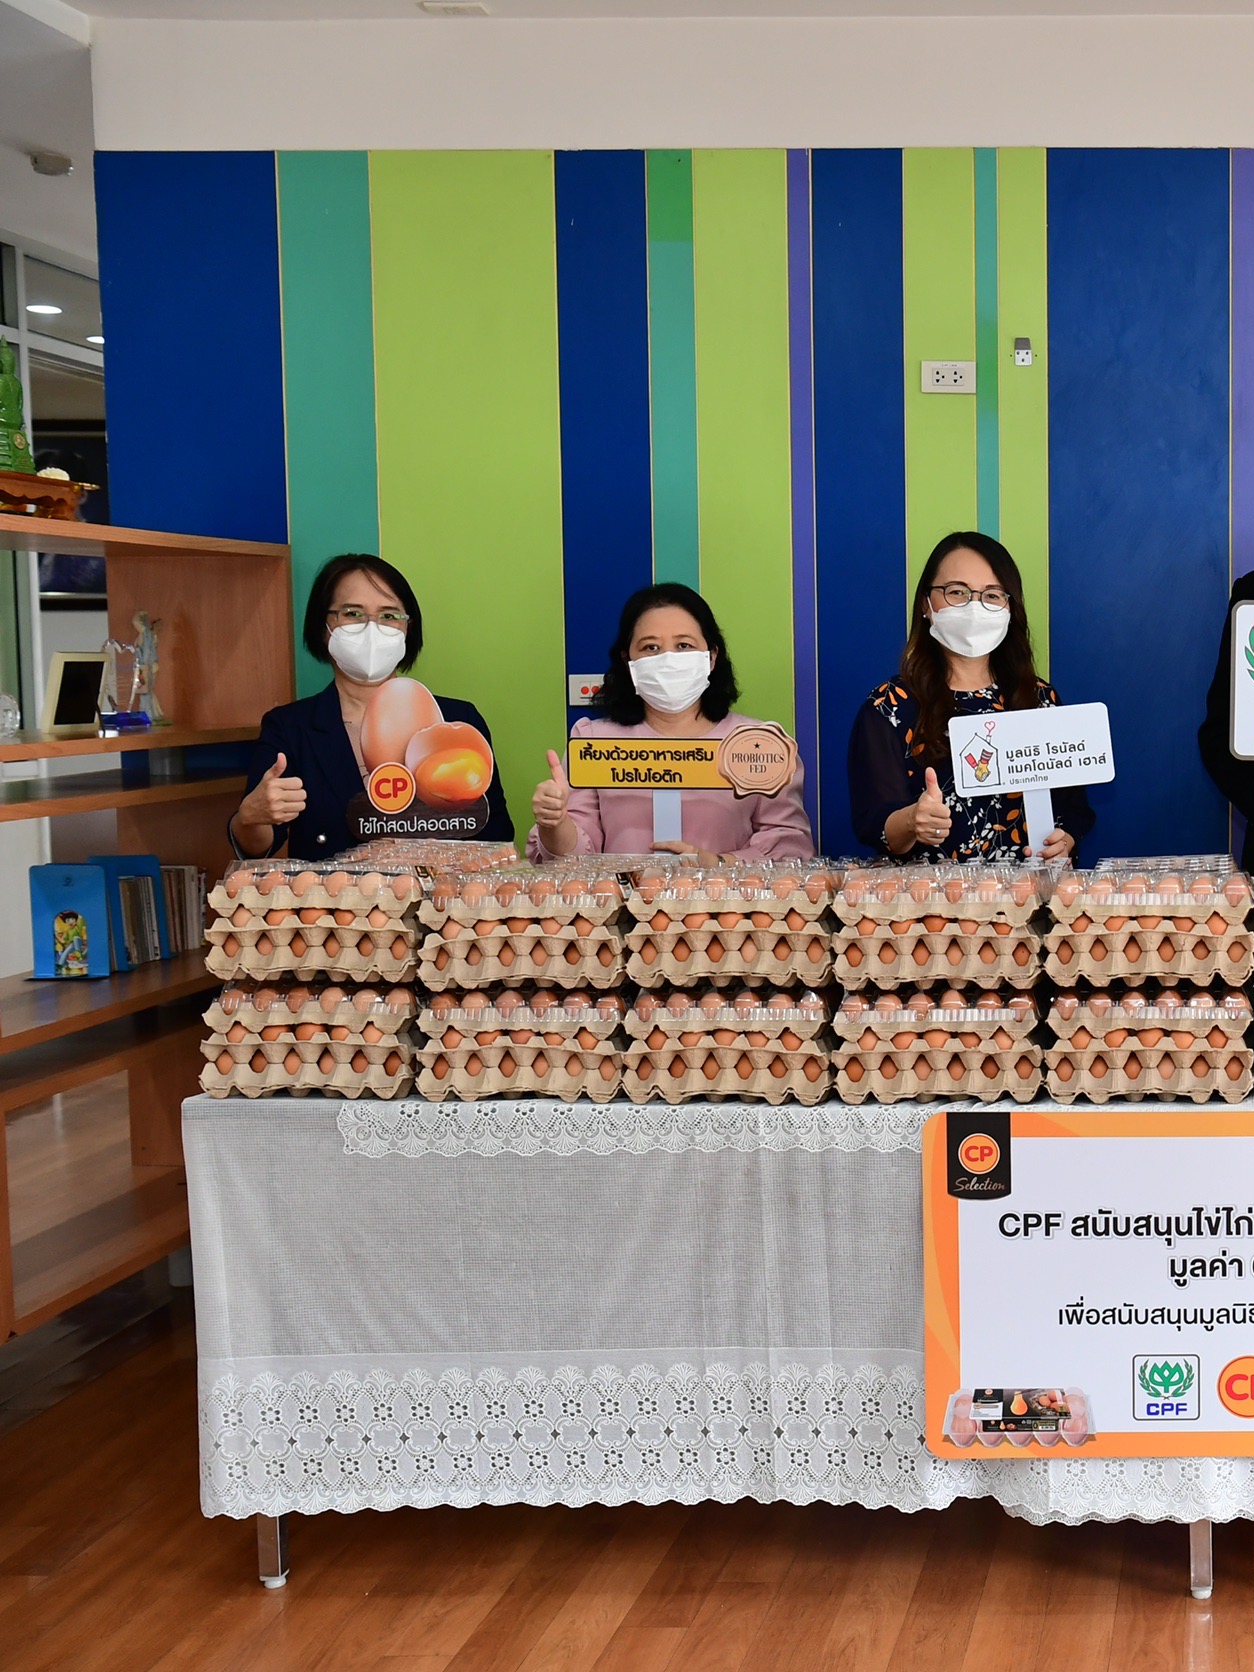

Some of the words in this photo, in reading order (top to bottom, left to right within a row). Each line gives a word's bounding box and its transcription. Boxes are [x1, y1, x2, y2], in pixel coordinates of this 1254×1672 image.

[580, 742, 714, 761] เลี้ยงด้วยอาหารเสริม
[731, 752, 785, 763] PROBIOTICS
[1005, 745, 1041, 762] มูลนิธิ
[1046, 739, 1086, 756] โรนัลด์
[749, 764, 767, 774] FED
[1007, 757, 1073, 774] แมคโดนัลด์
[1078, 753, 1107, 767] เฮาส์
[610, 767, 682, 783] โปรไบโอติก
[1009, 774, 1049, 786] ประเทศไทย
[374, 778, 408, 799] CP
[358, 816, 477, 834] ไข่ไก่สดปลอดสาร
[964, 1145, 994, 1162] CP
[953, 1176, 1005, 1192] Selection
[999, 1213, 1061, 1237] CPF
[1169, 1250, 1243, 1287] มูลค่า
[1146, 1403, 1187, 1416] CPF
